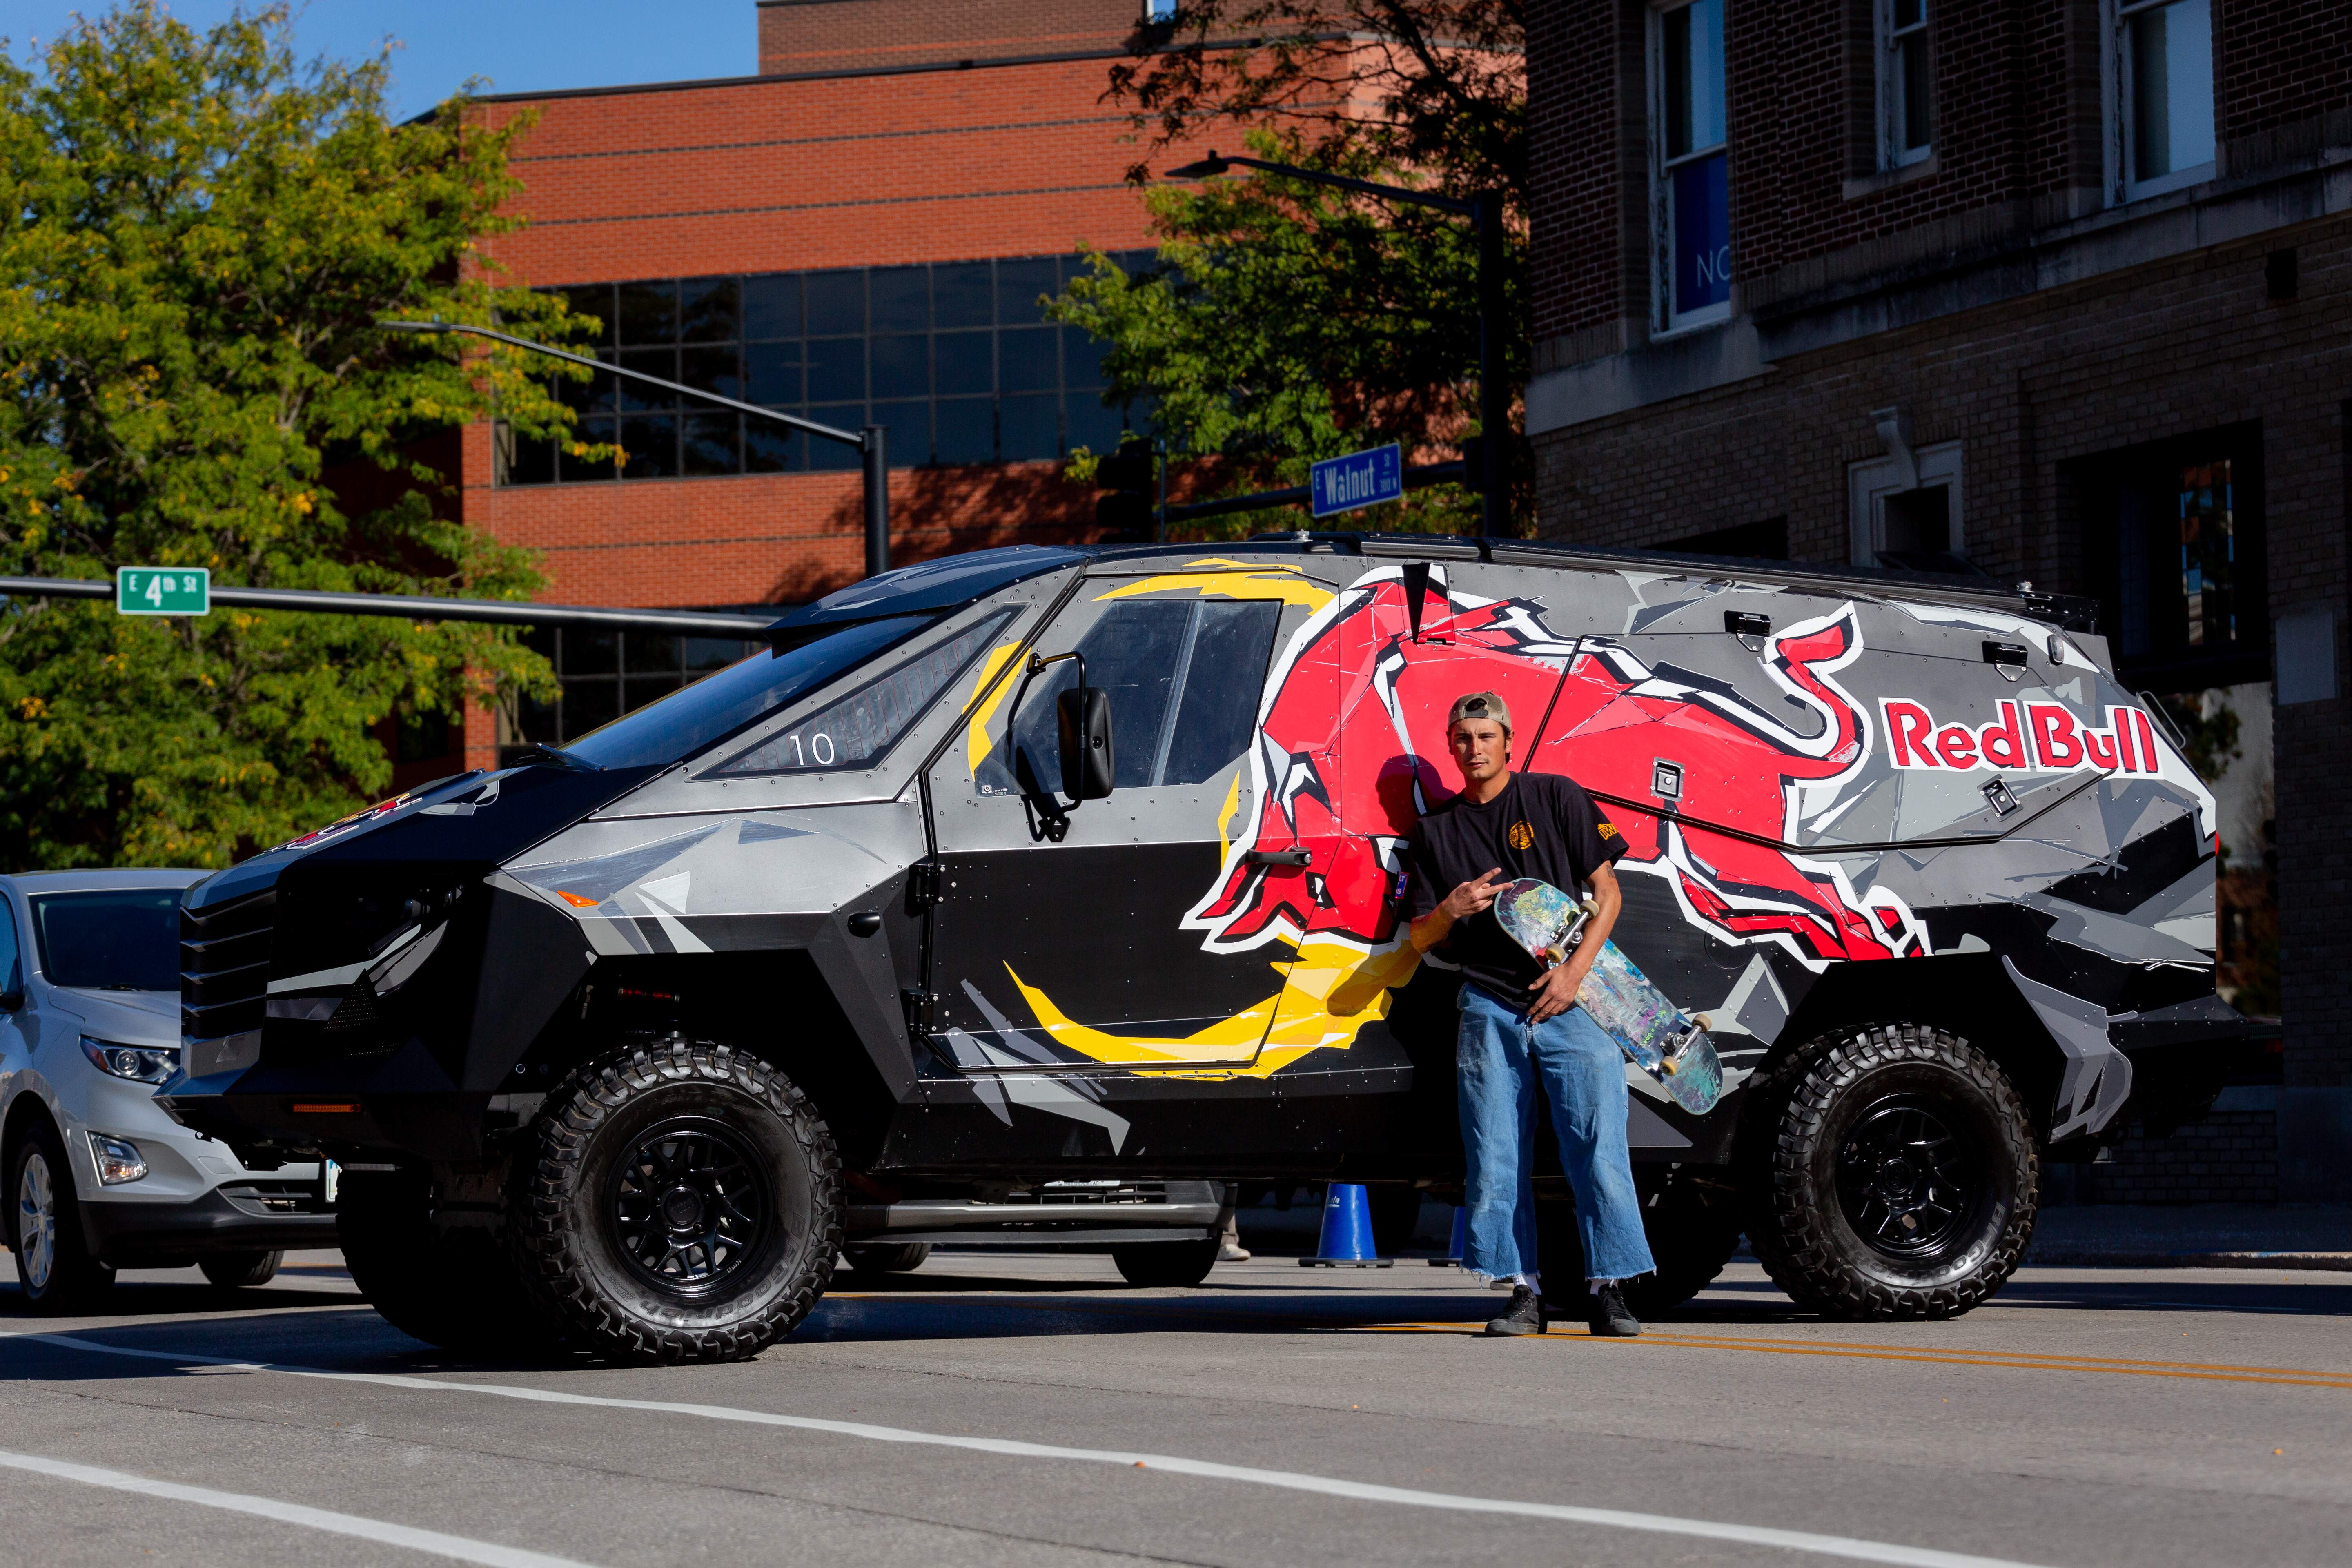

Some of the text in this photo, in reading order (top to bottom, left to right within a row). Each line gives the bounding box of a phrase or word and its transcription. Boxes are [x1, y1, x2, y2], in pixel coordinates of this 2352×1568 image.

[1315, 470, 1320, 490] E
[1324, 458, 1375, 506] Walnut
[129, 574, 138, 592] E
[789, 733, 835, 766] 10
[1885, 701, 2158, 773] Red Bull
[639, 1212, 807, 1320] BFGoodrich
[1853, 1201, 2007, 1281] BFGoodrich
